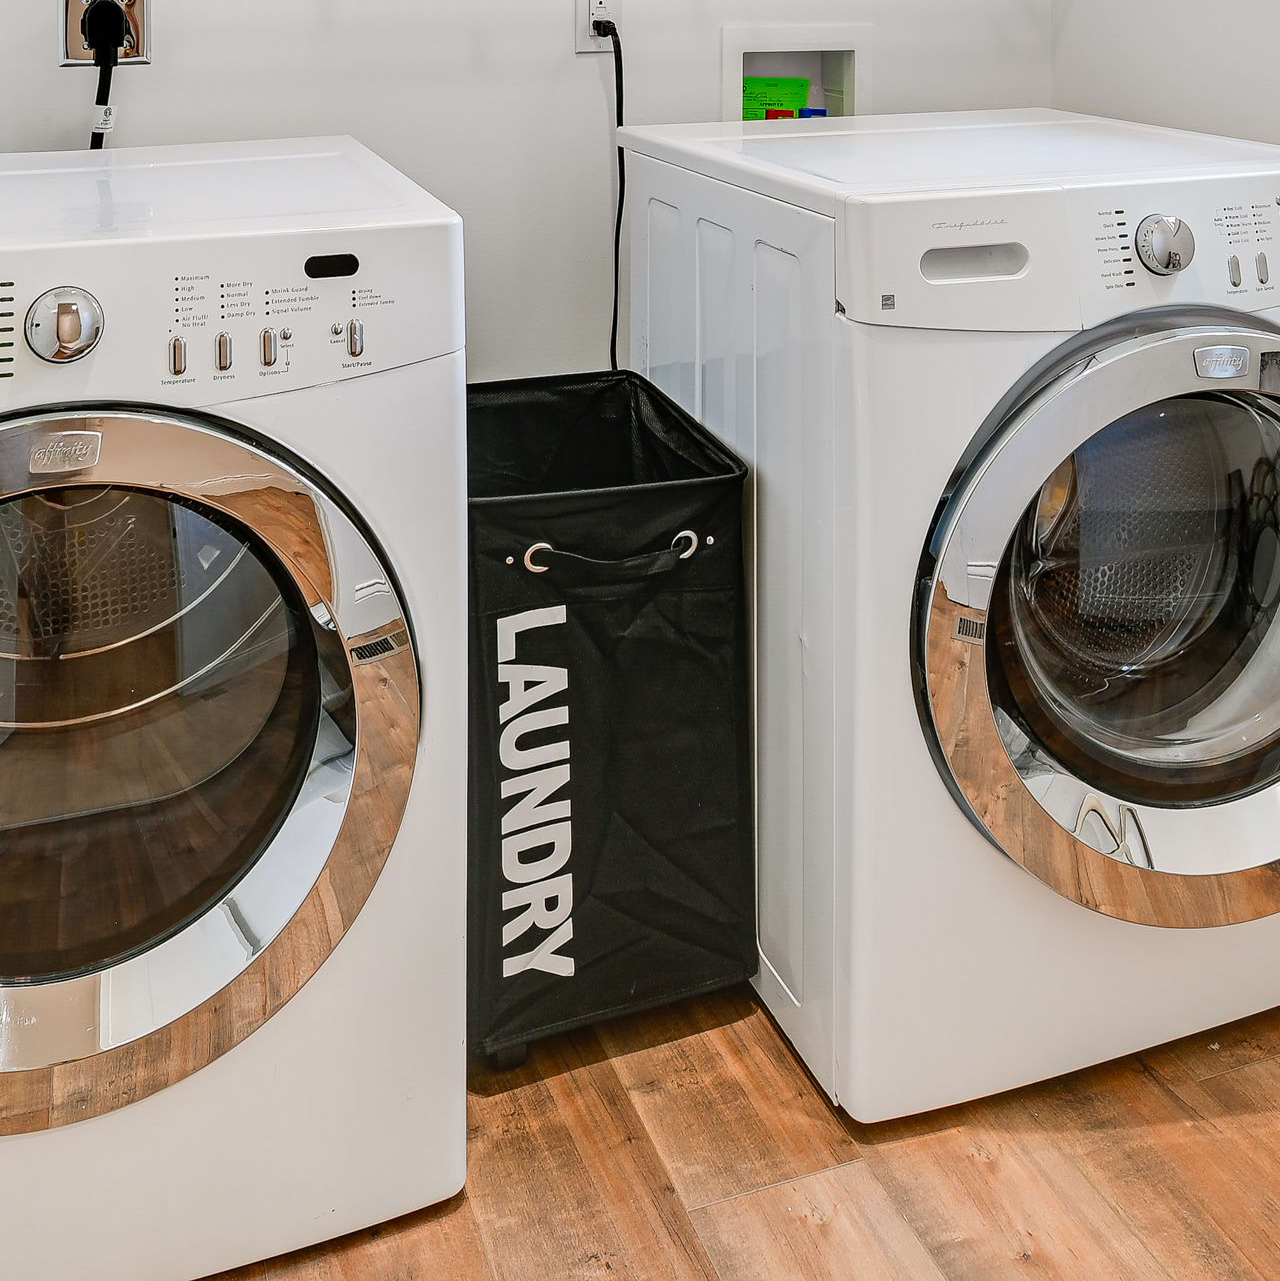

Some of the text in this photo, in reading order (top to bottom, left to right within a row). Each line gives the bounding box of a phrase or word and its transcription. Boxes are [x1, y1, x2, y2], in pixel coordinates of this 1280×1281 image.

[932, 219, 1008, 230] Frigidaire
[272, 297, 297, 305] Extended
[1203, 353, 1243, 371] affinity
[161, 378, 196, 386] Temperature
[35, 442, 92, 466] affinity
[496, 604, 574, 978] LAUNDRY
